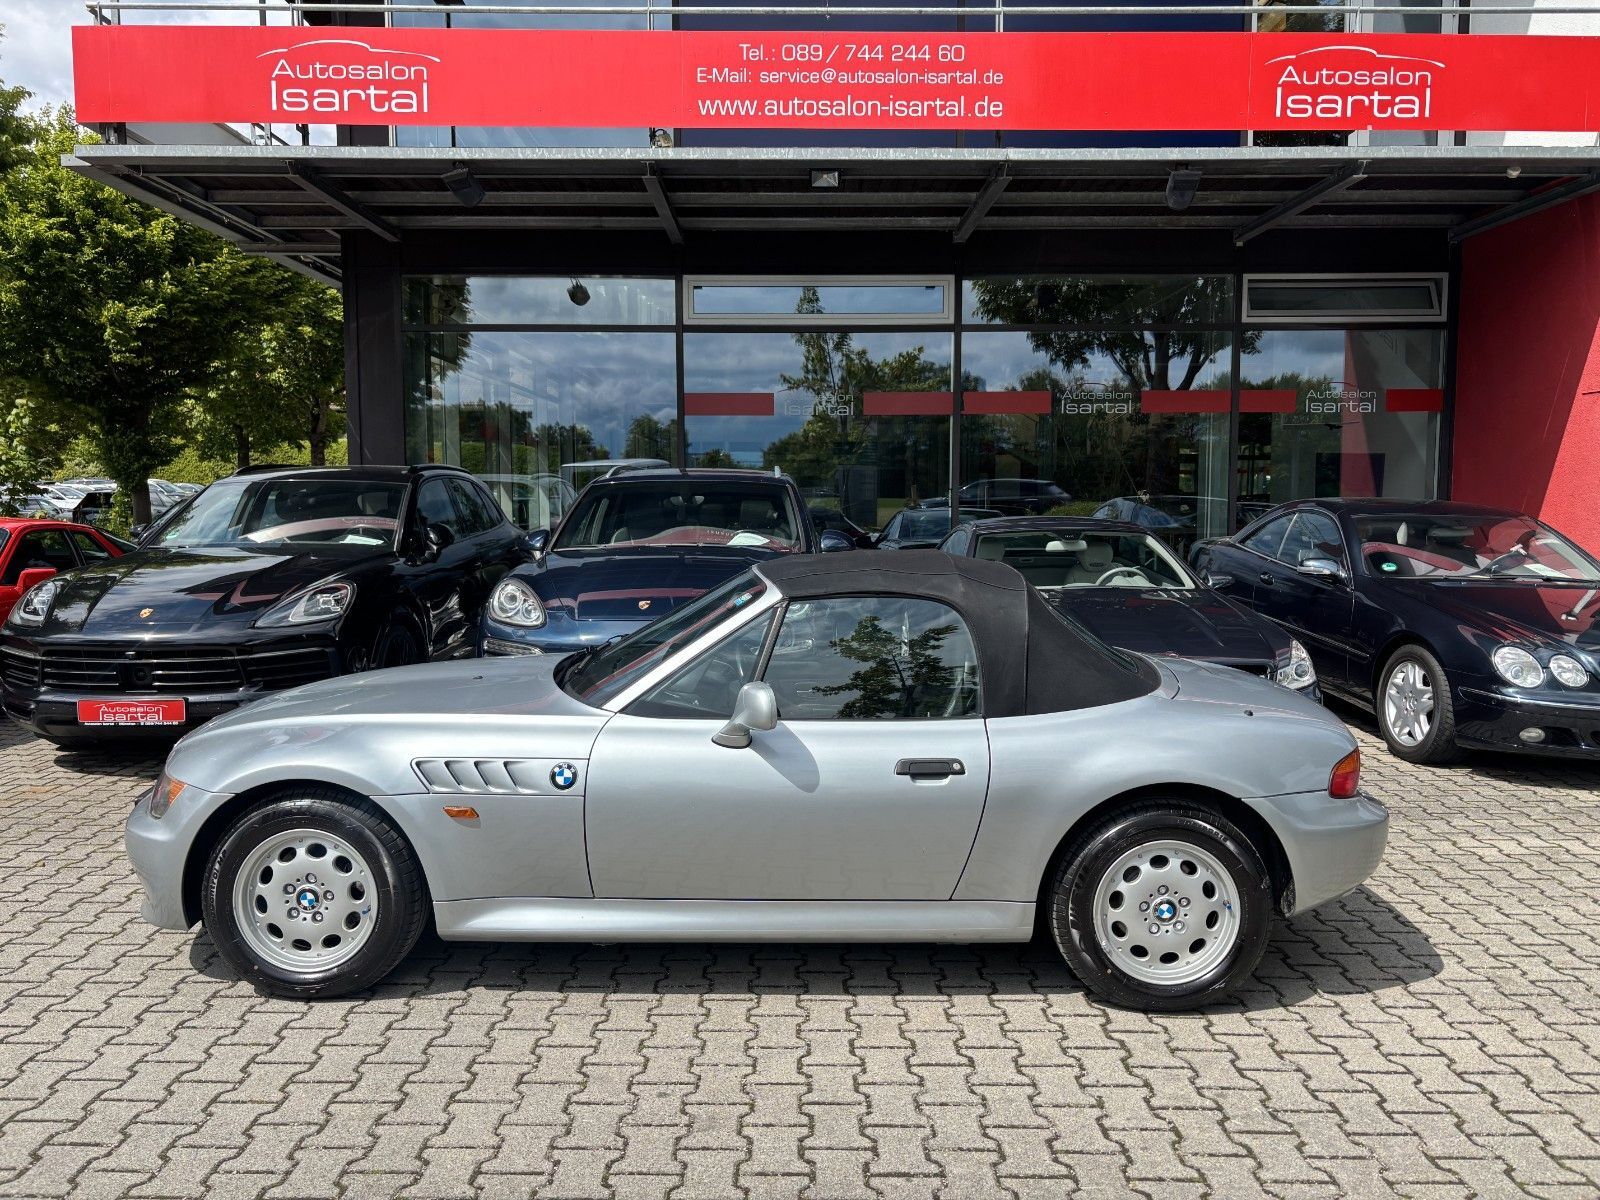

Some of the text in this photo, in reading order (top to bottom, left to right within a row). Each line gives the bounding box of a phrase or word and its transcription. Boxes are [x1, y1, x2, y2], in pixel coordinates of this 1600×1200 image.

[739, 44, 776, 61] Tel.:
[891, 44, 931, 61] 244
[938, 44, 966, 61] 60
[271, 59, 428, 80] Autosalon
[696, 67, 1004, 85] E-Mail: service@autosalon-isartal.de
[1278, 65, 1432, 86] Autosalon
[270, 80, 429, 113] Isartal
[1275, 87, 1431, 118] Isartal
[697, 95, 1004, 117] www.autosalon-isartal.de
[1061, 390, 1133, 400] Autosalon
[1306, 389, 1377, 399] Autosalon
[784, 401, 854, 416] Isartal
[1061, 399, 1132, 414] Isartal
[1305, 398, 1376, 413] Isartal
